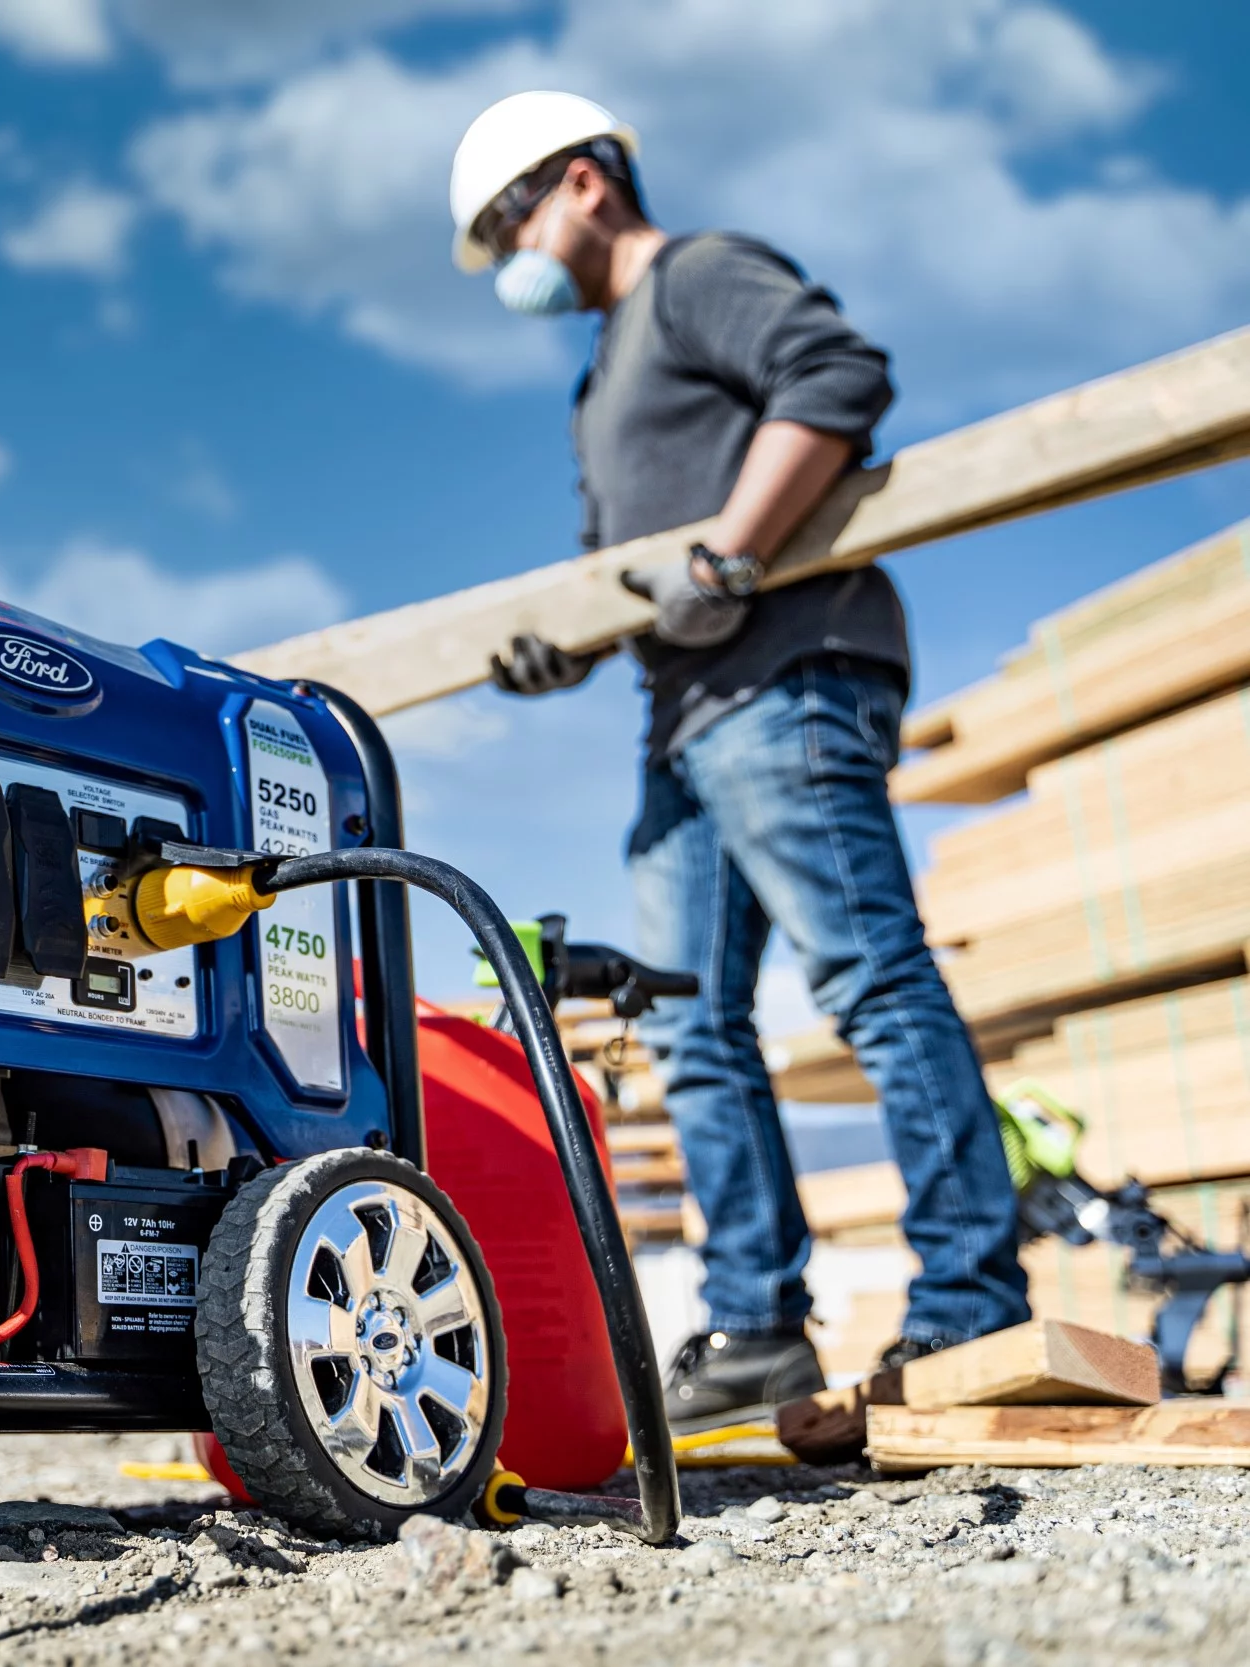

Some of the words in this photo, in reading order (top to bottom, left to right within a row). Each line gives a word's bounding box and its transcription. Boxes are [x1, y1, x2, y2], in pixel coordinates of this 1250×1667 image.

[0, 639, 70, 685] Ford
[250, 719, 278, 737] DUAL
[281, 728, 308, 747] FUEL
[67, 789, 100, 801] SELECTOR
[102, 796, 126, 808] SWITCH
[83, 784, 111, 797] VOLTAGE
[258, 777, 317, 817] 5250
[259, 807, 280, 820] GAS
[260, 818, 285, 834] PEAK
[287, 826, 319, 844] WATTS
[80, 856, 89, 864] AC
[265, 923, 326, 960] 4750
[88, 945, 101, 953] OUR
[102, 946, 123, 956] METER
[267, 952, 287, 965] LPG
[268, 965, 294, 980] PEAK
[296, 971, 327, 987] WATTS
[36, 991, 44, 999] AC
[45, 992, 55, 1000] 20A
[87, 992, 105, 1001] HOURS
[269, 984, 320, 1014] 3800
[57, 1008, 87, 1019] NEUTRAL
[88, 1011, 114, 1023] BONDED
[115, 1016, 125, 1024] TO
[125, 1017, 147, 1027] FRAME
[123, 1217, 138, 1227] 12V
[141, 1218, 157, 1228] 7Ah
[158, 1220, 176, 1230] 10Hr
[139, 1229, 160, 1238] 6-FM-7
